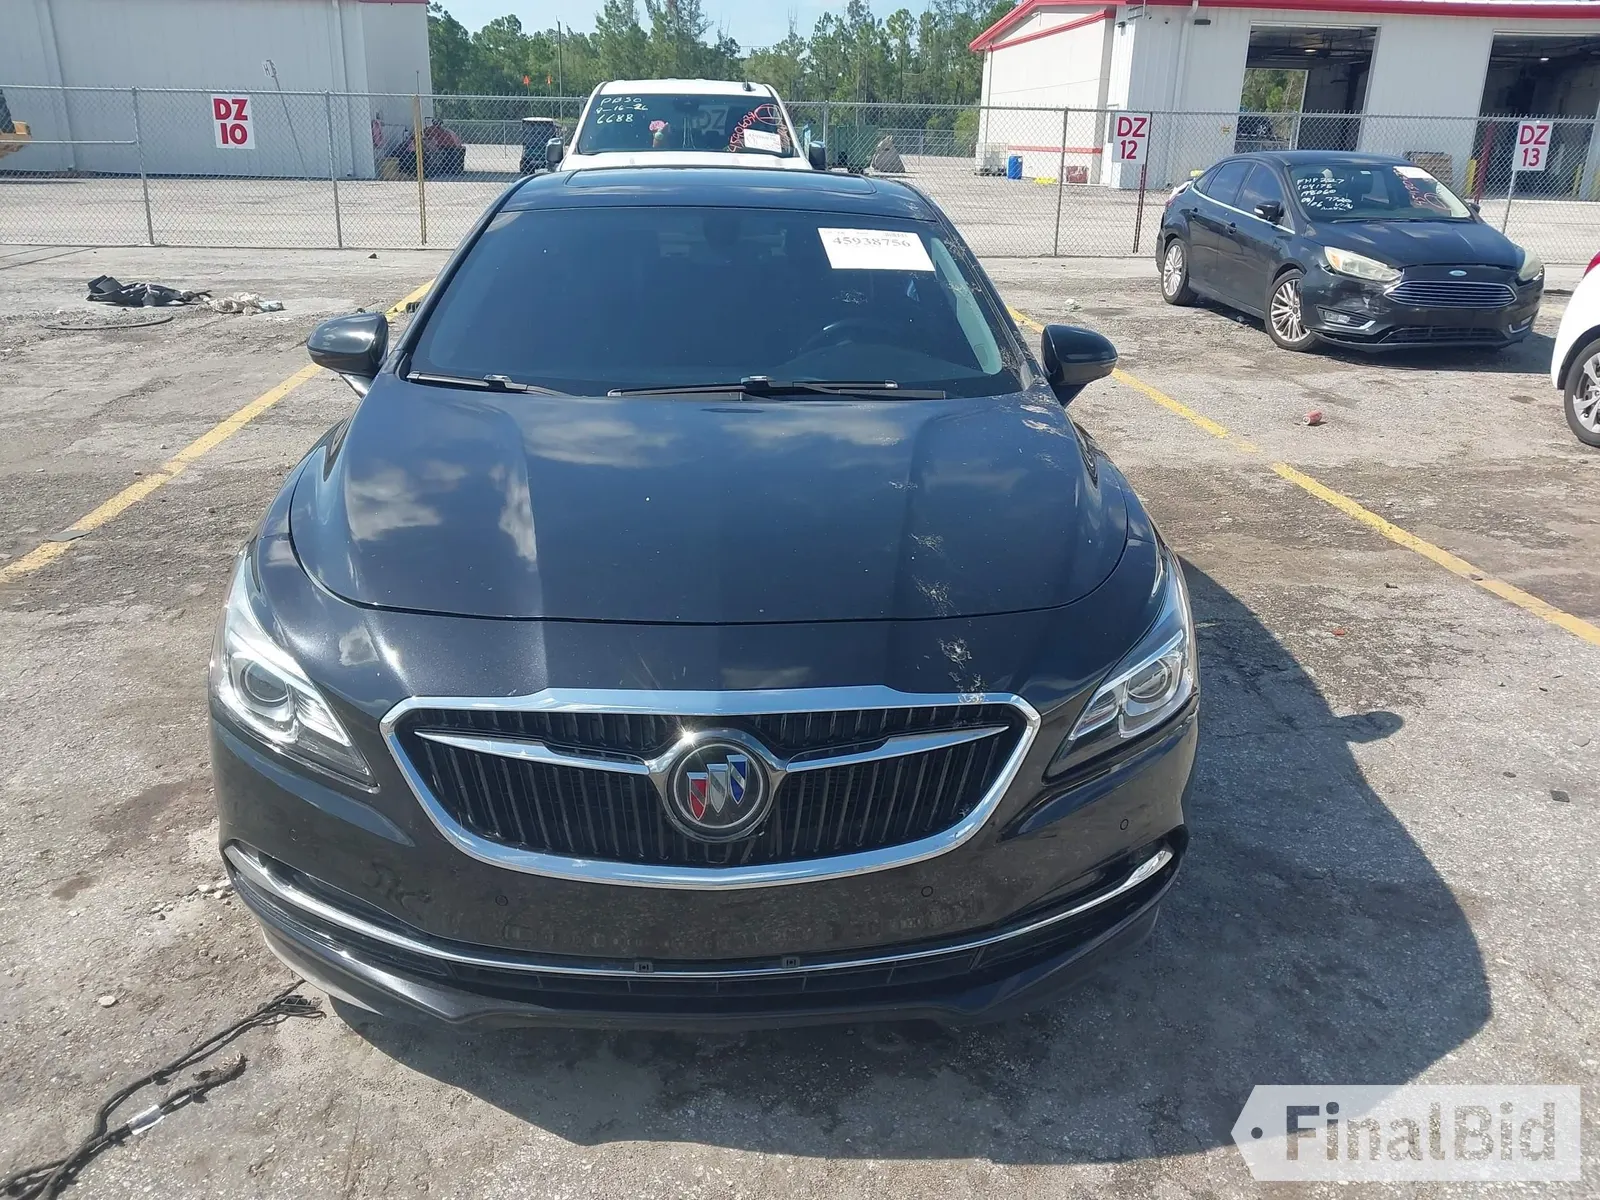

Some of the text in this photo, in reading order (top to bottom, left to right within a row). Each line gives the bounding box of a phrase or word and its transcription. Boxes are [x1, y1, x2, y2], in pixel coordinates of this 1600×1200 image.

[213, 98, 248, 121] DZ
[597, 113, 634, 124] 6688
[220, 122, 248, 145] 10
[1117, 116, 1147, 138] DZ
[1519, 125, 1549, 145] DZ
[1120, 139, 1138, 160] 12
[1522, 147, 1540, 167] 13
[833, 236, 911, 248] 45938756
